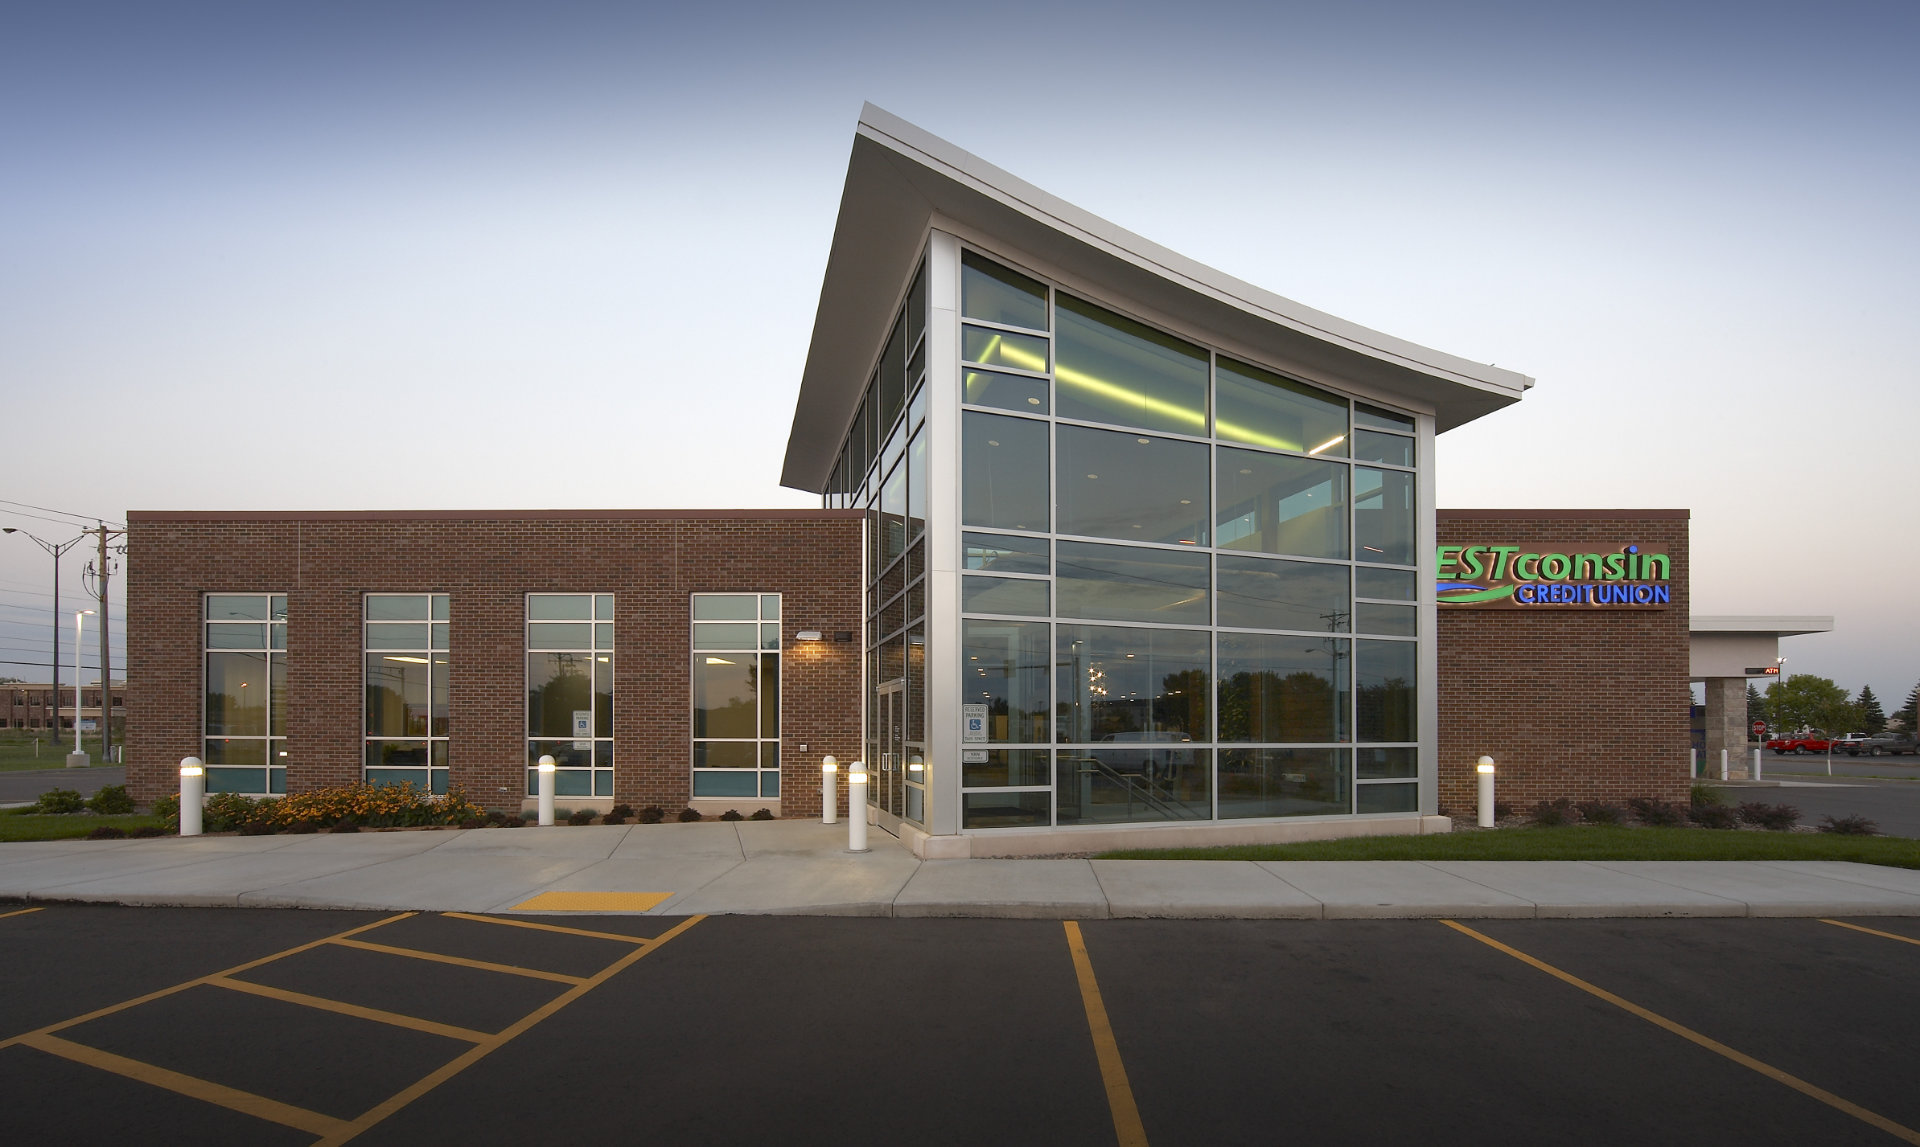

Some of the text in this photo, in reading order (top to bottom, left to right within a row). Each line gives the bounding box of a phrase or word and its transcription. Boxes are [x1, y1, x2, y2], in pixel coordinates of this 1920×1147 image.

[1436, 545, 1671, 580] ESTconsin
[1518, 584, 1670, 604] CREDIT UNION
